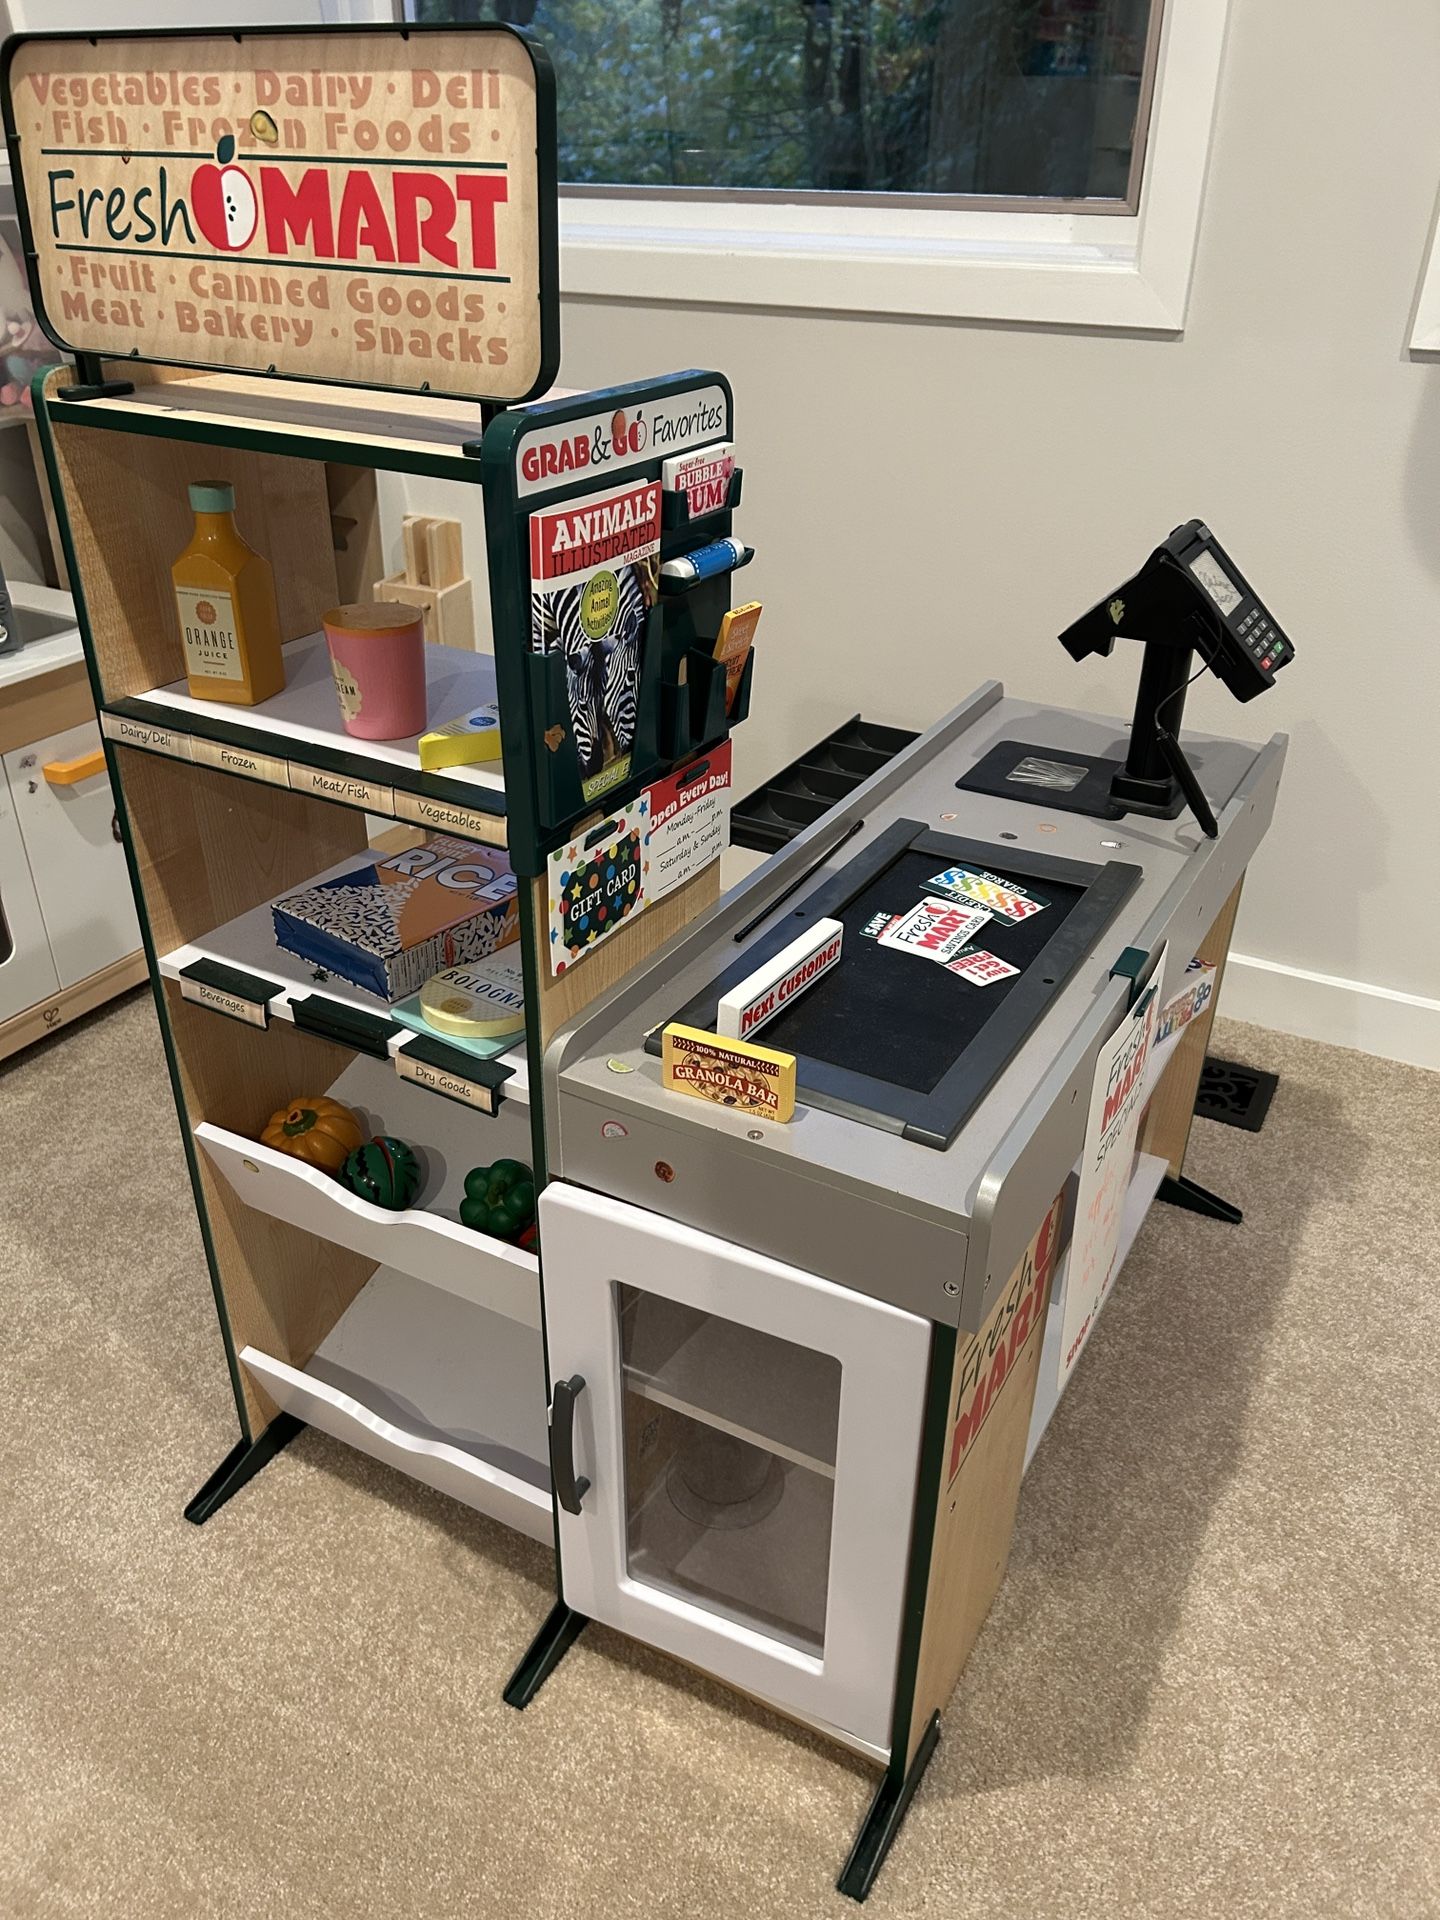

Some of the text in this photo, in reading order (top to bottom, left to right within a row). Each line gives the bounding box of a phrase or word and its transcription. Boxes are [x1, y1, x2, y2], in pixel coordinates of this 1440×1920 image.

[28, 68, 500, 109] Vegetables Dairy Deli
[52, 110, 471, 153] Fish Frozn Foods
[48, 165, 508, 269] Fresh MART
[69, 255, 485, 323] Fruit Canned Goods
[61, 290, 508, 366] Meat Bakery Snacks
[652, 401, 723, 446] Favorites
[679, 462, 723, 490] BUBBLE
[687, 480, 723, 514] UM
[552, 490, 656, 553] ANIMALS
[552, 521, 656, 577] ILLUSTRATED
[623, 543, 655, 565] MAGAZINE
[591, 593, 611, 613] Animal
[186, 627, 234, 649] ORANGE
[198, 650, 228, 659] JUICE
[120, 723, 171, 747] Dairy/Deli
[221, 751, 257, 771] Frozen
[312, 775, 370, 800] Meat/Fish
[650, 771, 728, 832] Open Every Day!
[418, 802, 481, 831] Vegetables
[660, 824, 721, 873] Saturday & Sunday
[379, 847, 518, 901] RICE
[980, 871, 1028, 895] CHARGE
[570, 863, 636, 922] GIFT CARD
[864, 912, 892, 937] SAVE
[896, 911, 941, 945] Fresh
[916, 909, 973, 951] MART
[940, 929, 970, 955] SAVINGS
[965, 915, 986, 932] CARD
[948, 952, 994, 971] FREE!
[974, 961, 1000, 971] Get
[986, 966, 1011, 977] Buy
[200, 987, 245, 1013] Beverages
[441, 970, 524, 1008] BOLOGNA
[742, 939, 840, 1034] Next Customer
[696, 1045, 758, 1068] 100% NATURAL
[415, 1066, 471, 1098] Dry Goods
[675, 1066, 777, 1106] GRANOLA BAR
[956, 1251, 1032, 1422] Fresh
[948, 1256, 1051, 1484] MART
